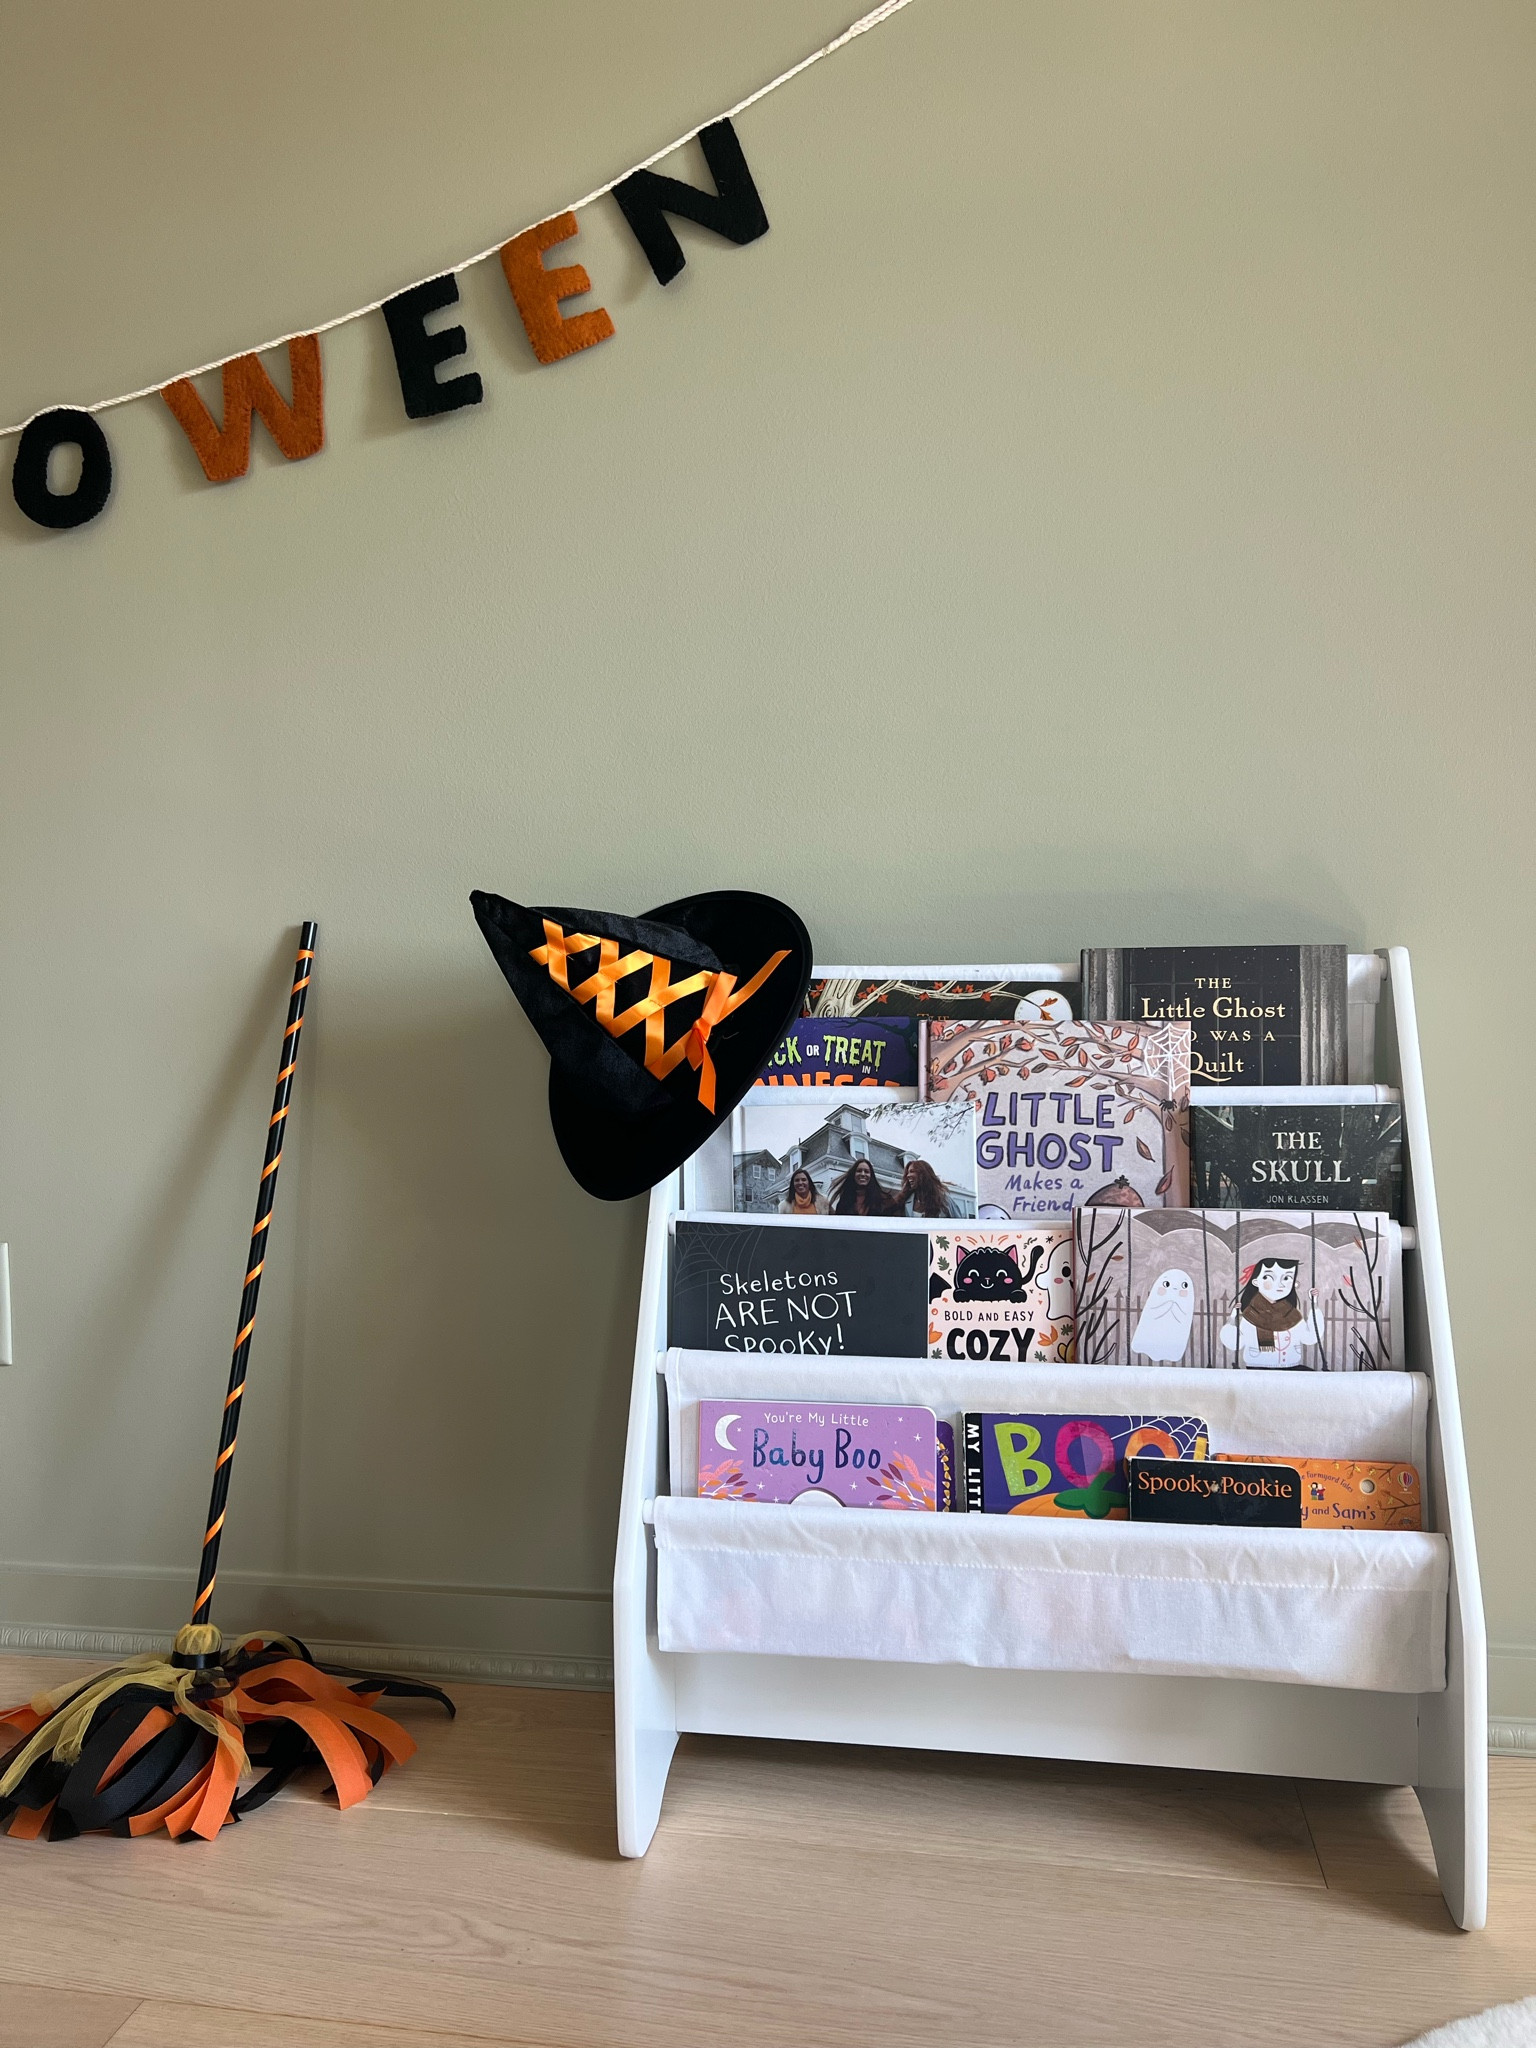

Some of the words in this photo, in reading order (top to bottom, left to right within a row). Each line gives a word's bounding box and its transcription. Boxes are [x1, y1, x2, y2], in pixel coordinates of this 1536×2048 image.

[1195, 977, 1232, 989] THE
[1141, 997, 1206, 1018] Little
[1212, 996, 1286, 1018] Ghost
[1210, 1030, 1251, 1042] WAS
[1263, 1030, 1276, 1042] A
[806, 1044, 820, 1056] OR
[823, 1035, 887, 1072] TREAT
[862, 1065, 872, 1074] IN
[1191, 1051, 1245, 1082] Quilt
[982, 1092, 1115, 1128] LITTLE
[976, 1130, 1124, 1172] GHOST
[1272, 1131, 1322, 1150] THE
[1004, 1171, 1063, 1192] Makes
[1070, 1178, 1084, 1190] a
[1252, 1160, 1351, 1183] SKULL
[1013, 1193, 1075, 1213] Friend
[1267, 1195, 1285, 1204] JON
[1287, 1195, 1329, 1205] KLASSEN
[720, 1270, 838, 1295] Skeletons
[715, 1298, 779, 1330] ARE
[787, 1291, 857, 1322] NOT
[944, 1310, 973, 1321] BOLD
[978, 1312, 999, 1322] AND
[1004, 1310, 1034, 1322] EASY
[946, 1327, 1036, 1363] COZY
[764, 1411, 802, 1424] You're
[808, 1412, 825, 1427] My
[831, 1413, 869, 1427] Little
[966, 1423, 980, 1453] MY
[753, 1427, 824, 1484] Baby
[835, 1428, 881, 1469] Boo
[1138, 1471, 1217, 1498] Spooky
[1221, 1476, 1293, 1499] Pookie
[1312, 1506, 1330, 1516] and
[1332, 1502, 1376, 1520] Sam's
